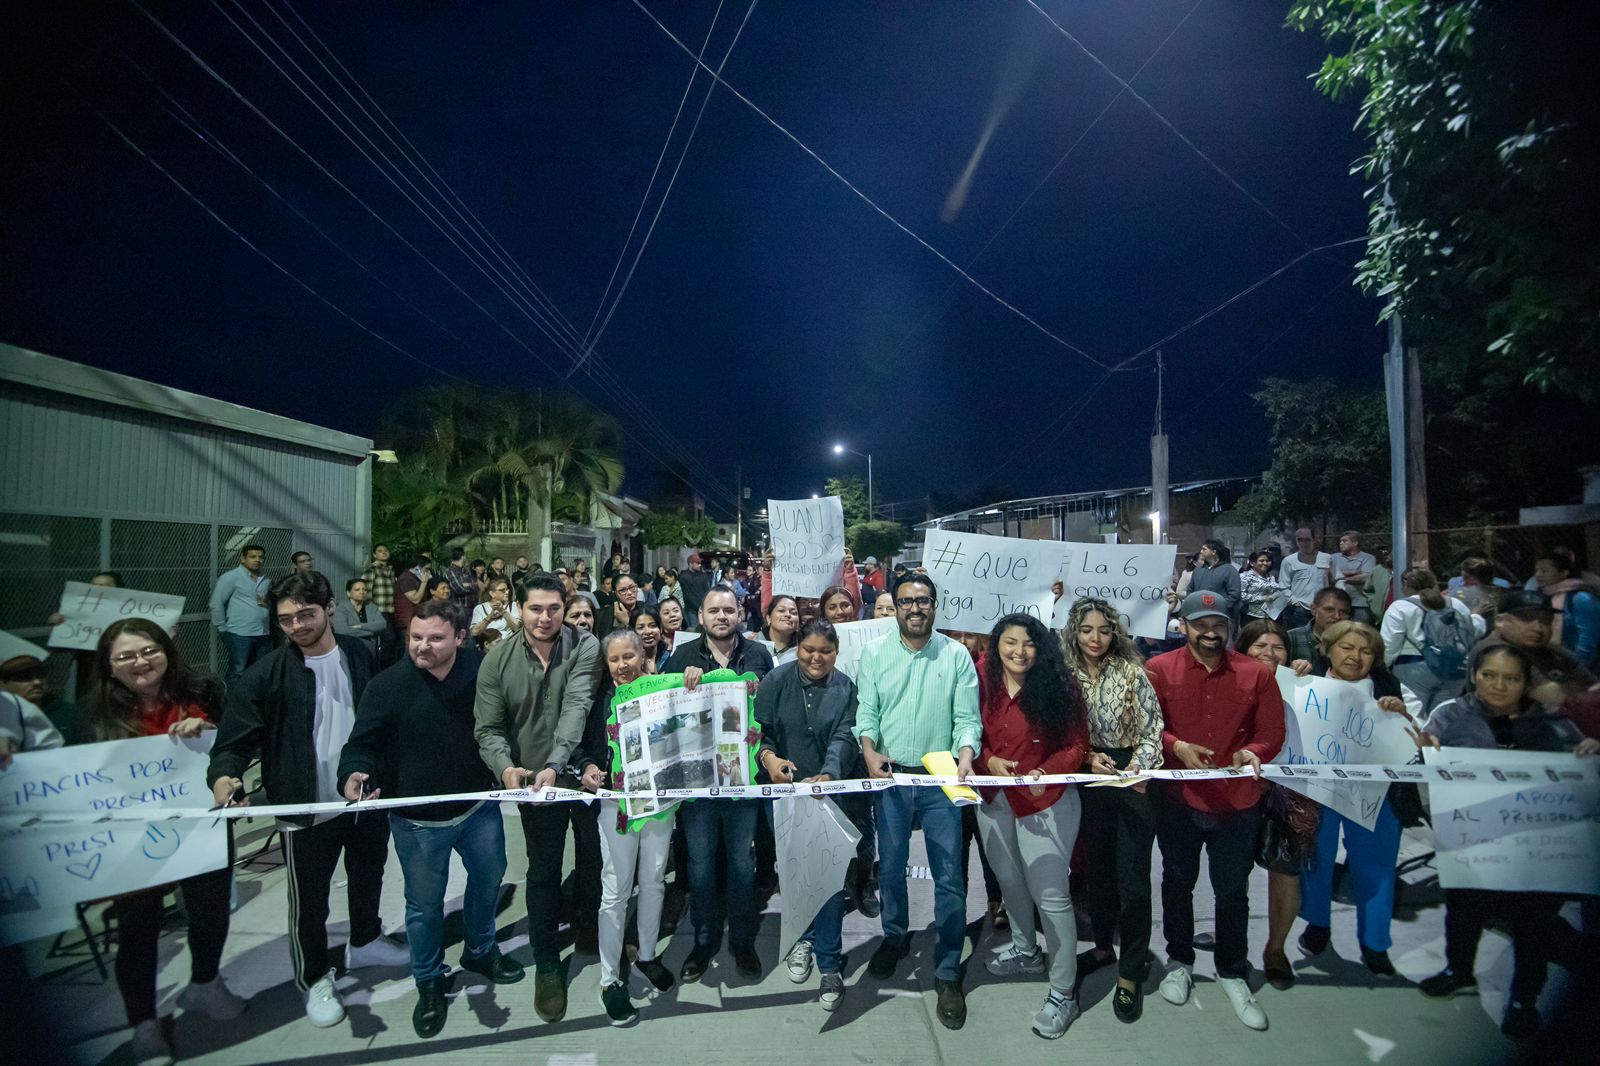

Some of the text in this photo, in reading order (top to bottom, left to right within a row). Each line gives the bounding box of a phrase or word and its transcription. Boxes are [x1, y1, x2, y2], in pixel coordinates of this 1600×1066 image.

[771, 503, 823, 534] JUAN
[773, 535, 823, 560] DIOS
[1082, 551, 1108, 574] La
[1123, 555, 1139, 577] 6
[935, 584, 973, 620] iga
[1074, 585, 1132, 601] enero
[130, 757, 178, 780] POR
[1452, 809, 1481, 822] AL
